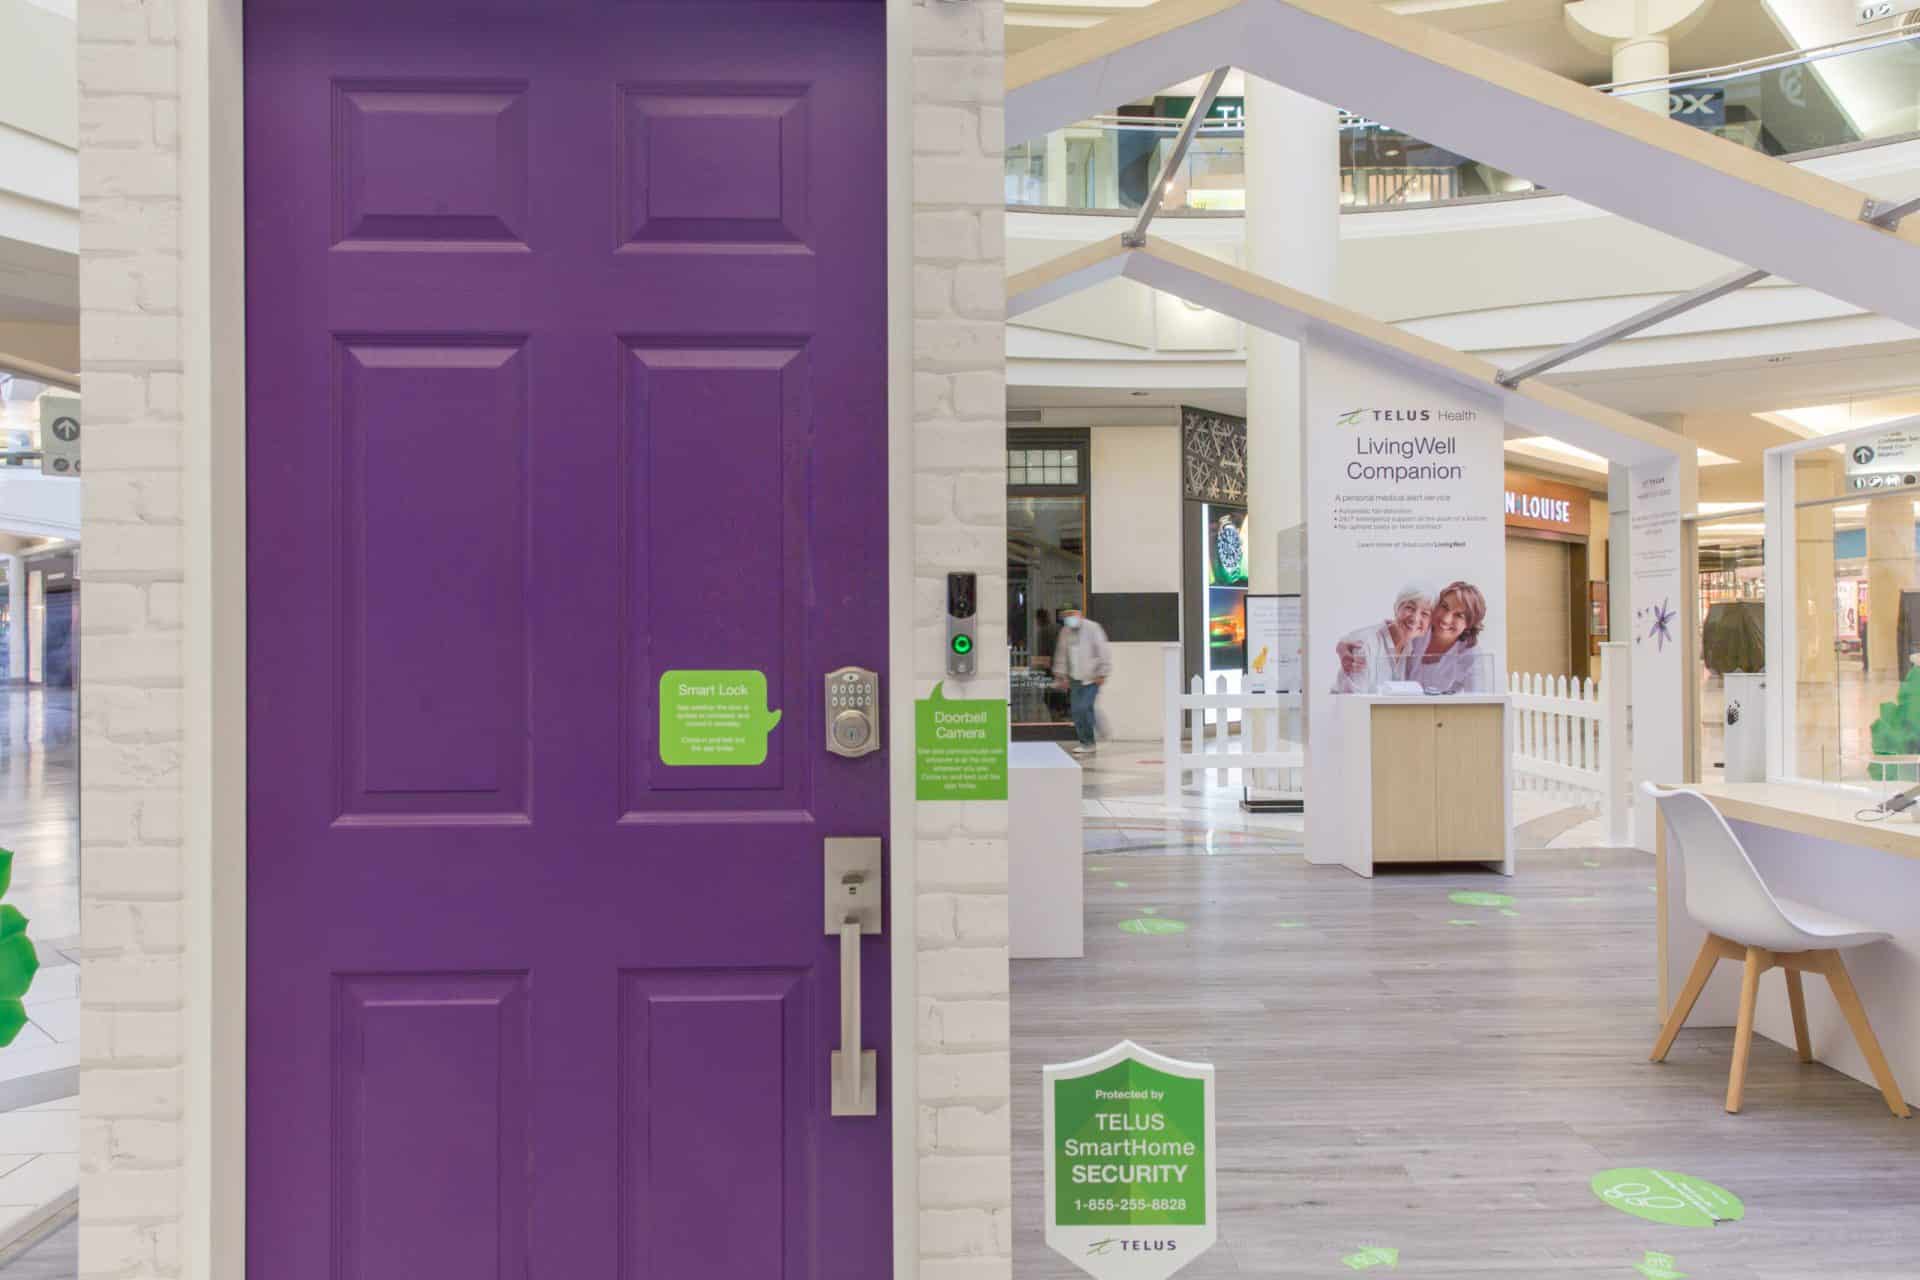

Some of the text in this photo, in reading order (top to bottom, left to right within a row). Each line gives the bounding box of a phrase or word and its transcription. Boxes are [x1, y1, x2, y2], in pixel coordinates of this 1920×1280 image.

[1373, 409, 1477, 421] TELUS Health
[1356, 436, 1456, 459] LivingWell
[1347, 462, 1462, 484] Companion
[1522, 494, 1570, 523] LOUISE
[679, 684, 748, 697] Smart Lock
[935, 711, 987, 724] Doorbell
[936, 727, 985, 739] Camera
[1095, 1089, 1164, 1102] Protected by
[1095, 1113, 1165, 1132] TELUS
[1064, 1138, 1196, 1157] SmartHome
[1072, 1164, 1188, 1184] SECURITY
[1074, 1199, 1187, 1211] 1-855-255-8828
[1120, 1239, 1177, 1252] TELUS
